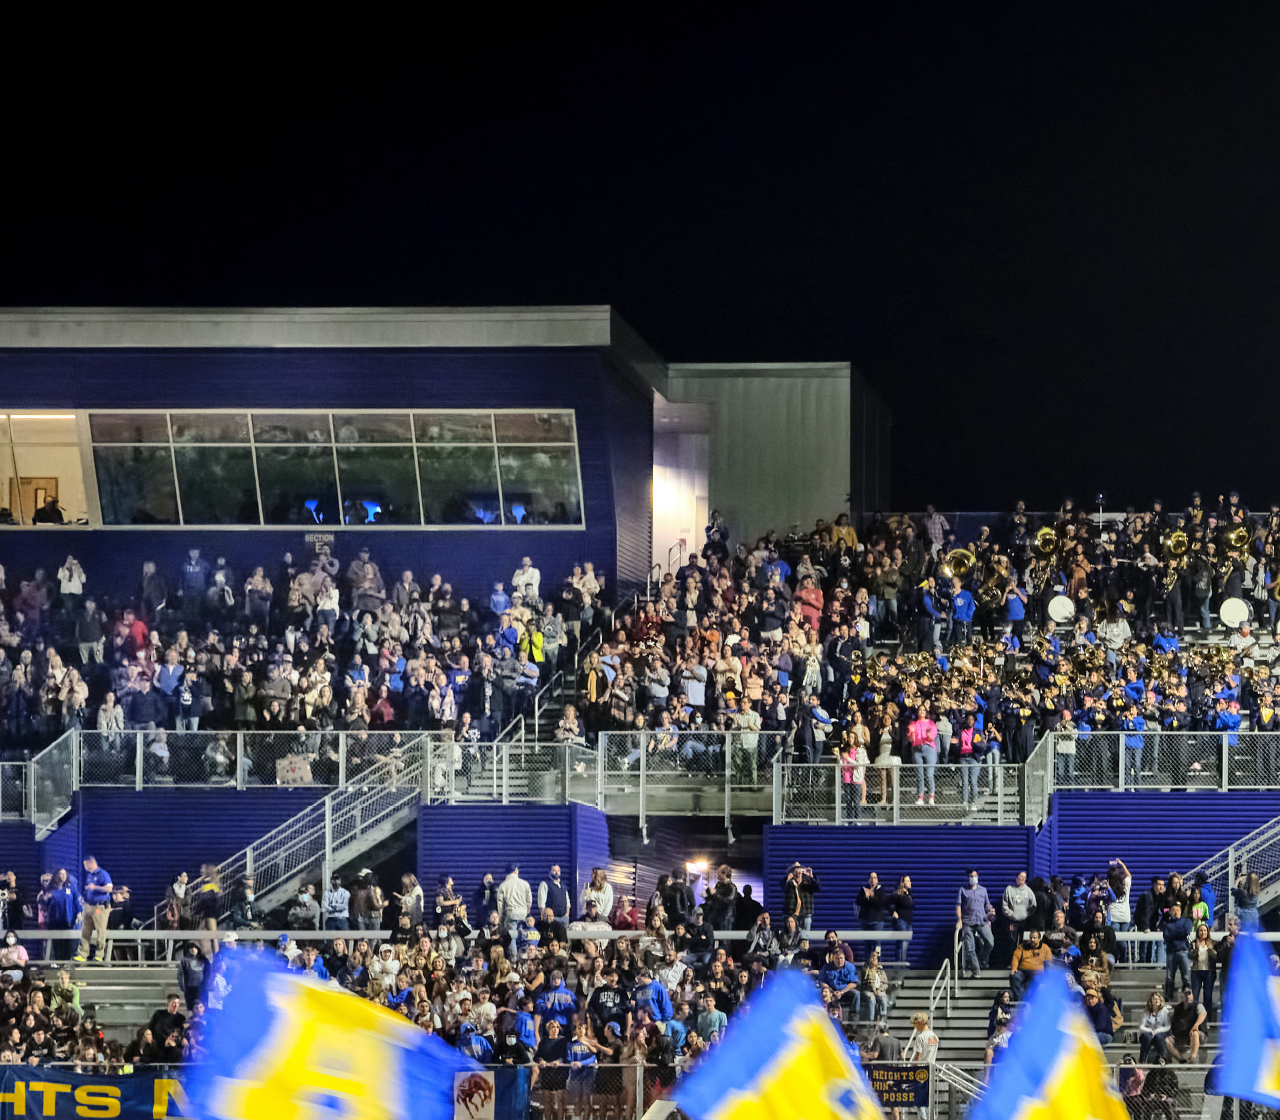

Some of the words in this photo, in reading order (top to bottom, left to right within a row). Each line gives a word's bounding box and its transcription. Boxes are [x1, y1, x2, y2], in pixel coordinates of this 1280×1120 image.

[304, 534, 335, 542] SECTION
[872, 1070, 915, 1081] HEIGHTS
[883, 1092, 915, 1102] POSSE
